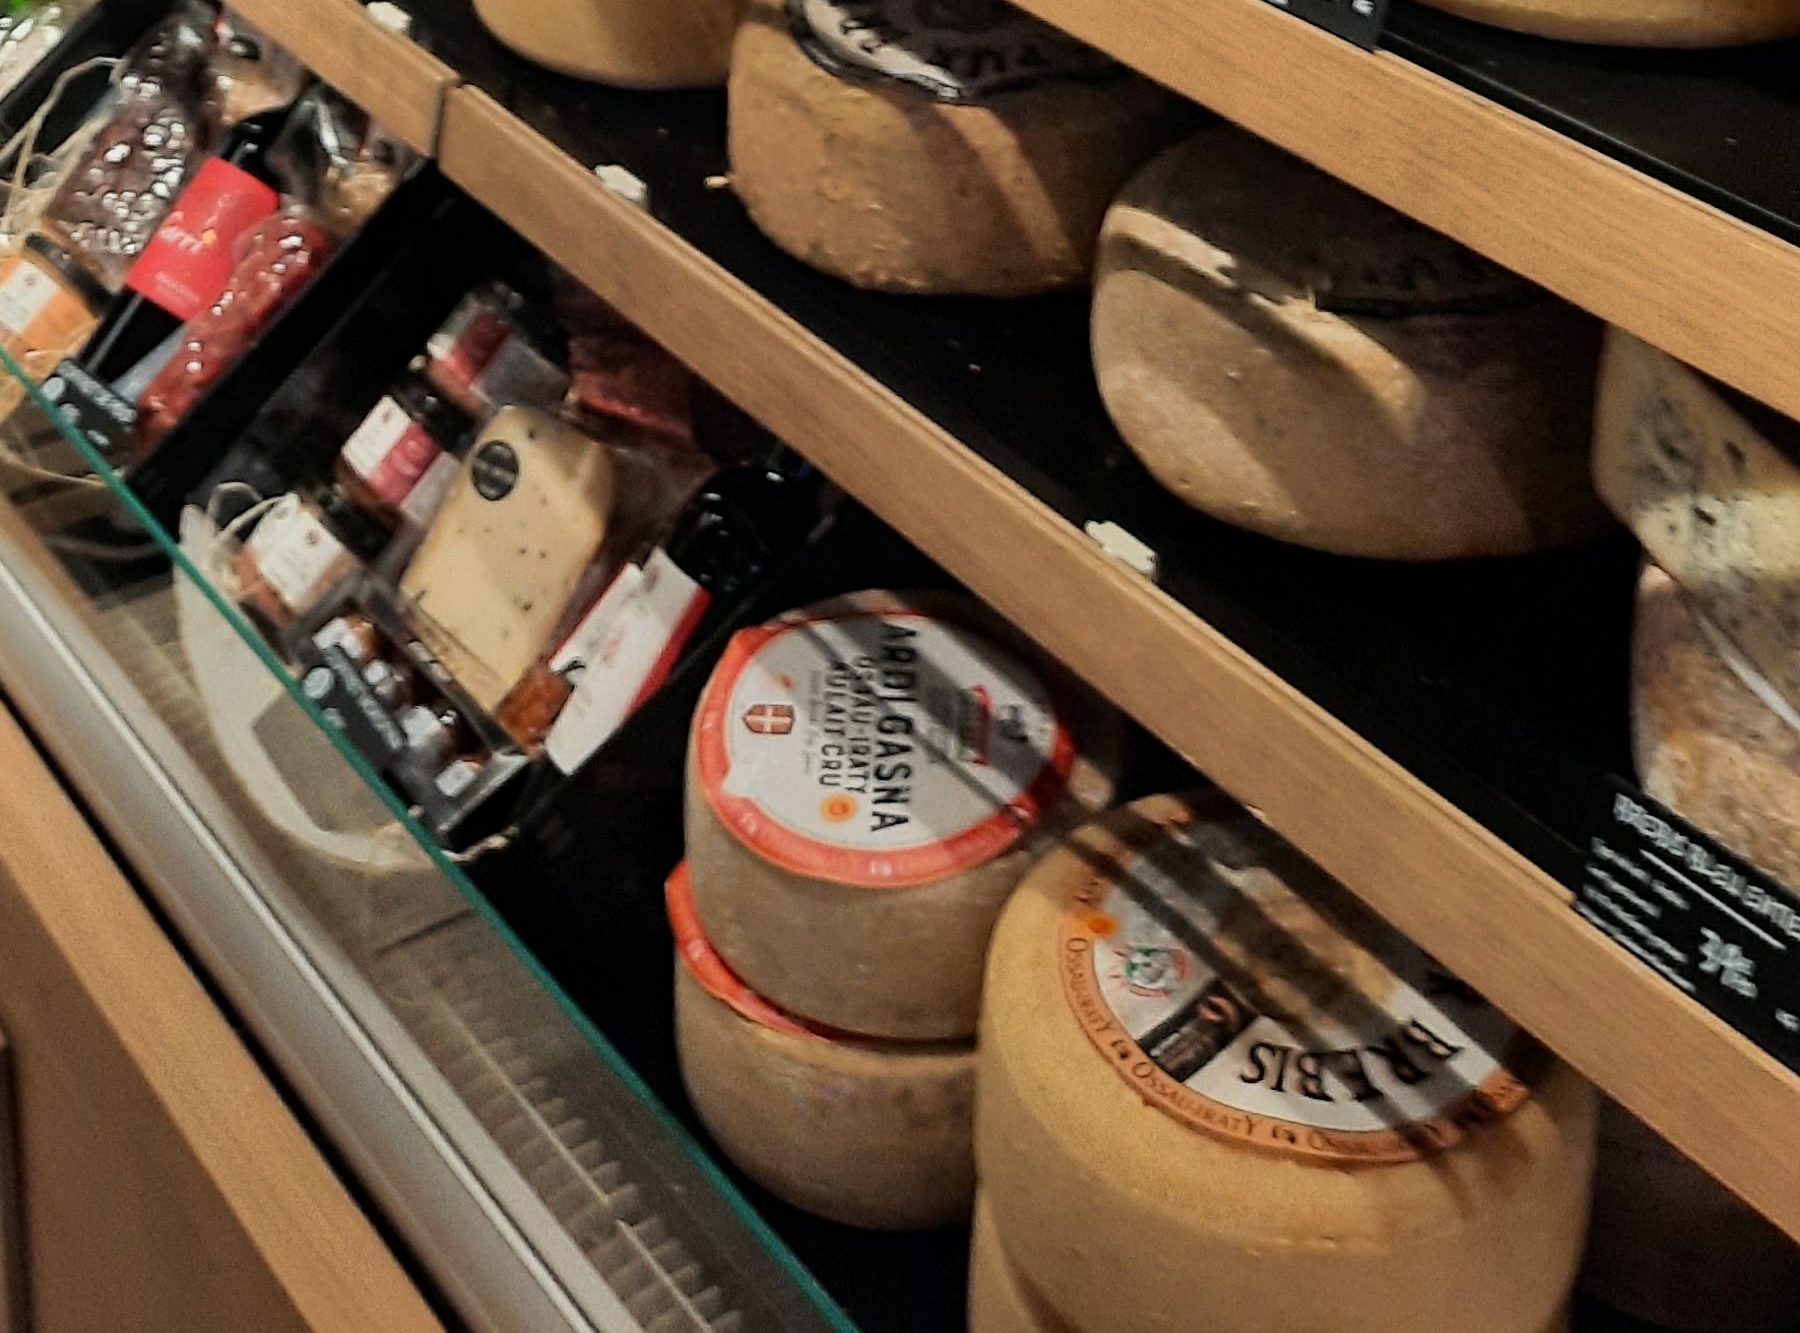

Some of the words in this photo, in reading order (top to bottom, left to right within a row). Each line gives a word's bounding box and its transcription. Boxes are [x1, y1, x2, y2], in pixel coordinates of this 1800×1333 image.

[818, 742, 845, 788] CRU
[871, 715, 914, 833] GASNA
[1240, 1017, 1460, 1103] BREBIS
